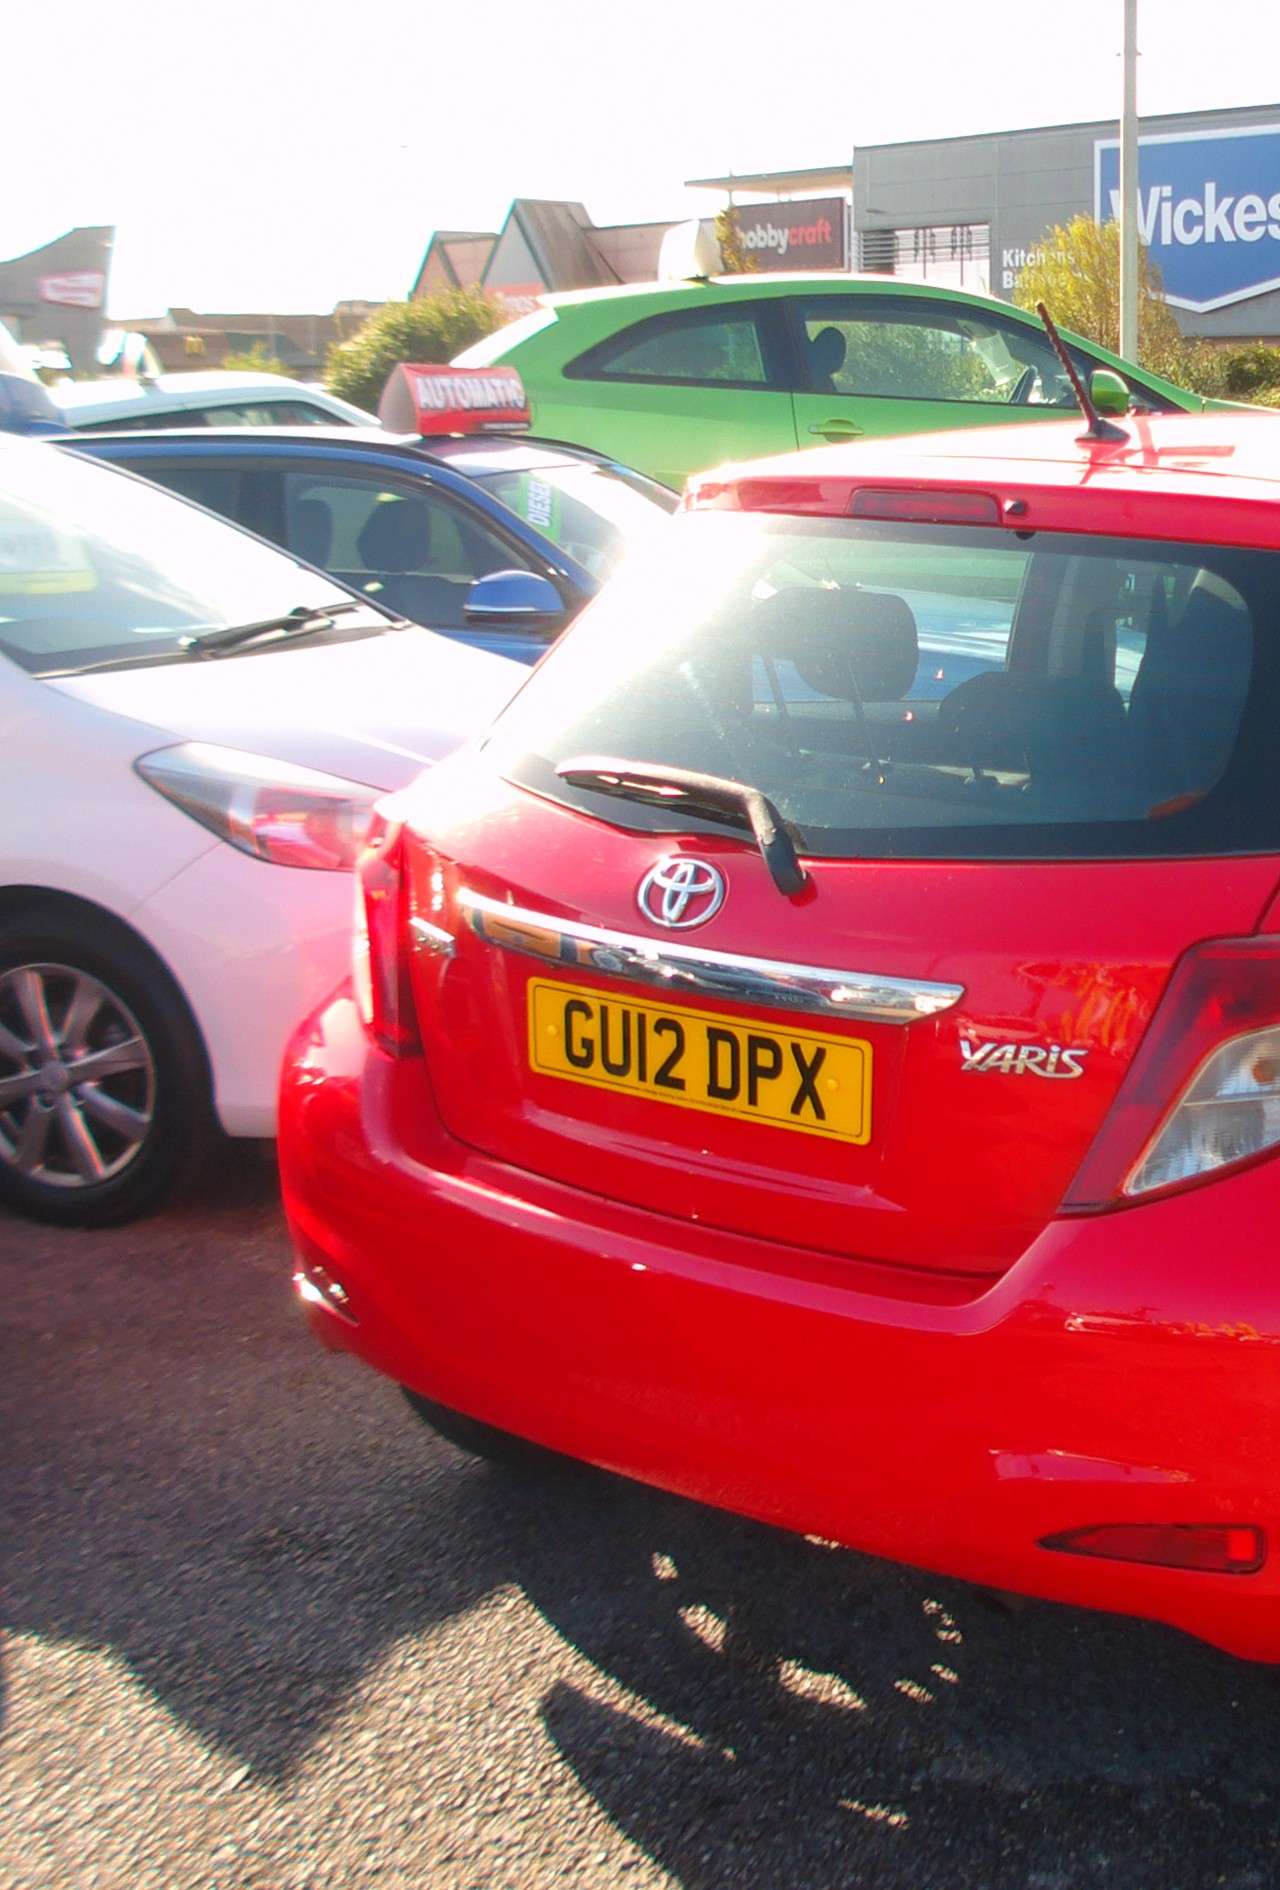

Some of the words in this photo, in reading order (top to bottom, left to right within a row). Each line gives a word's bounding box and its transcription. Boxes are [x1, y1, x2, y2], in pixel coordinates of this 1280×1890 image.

[415, 376, 528, 409] AUTOMATIC
[564, 999, 686, 1091] GU12
[706, 1025, 827, 1122] DPX
